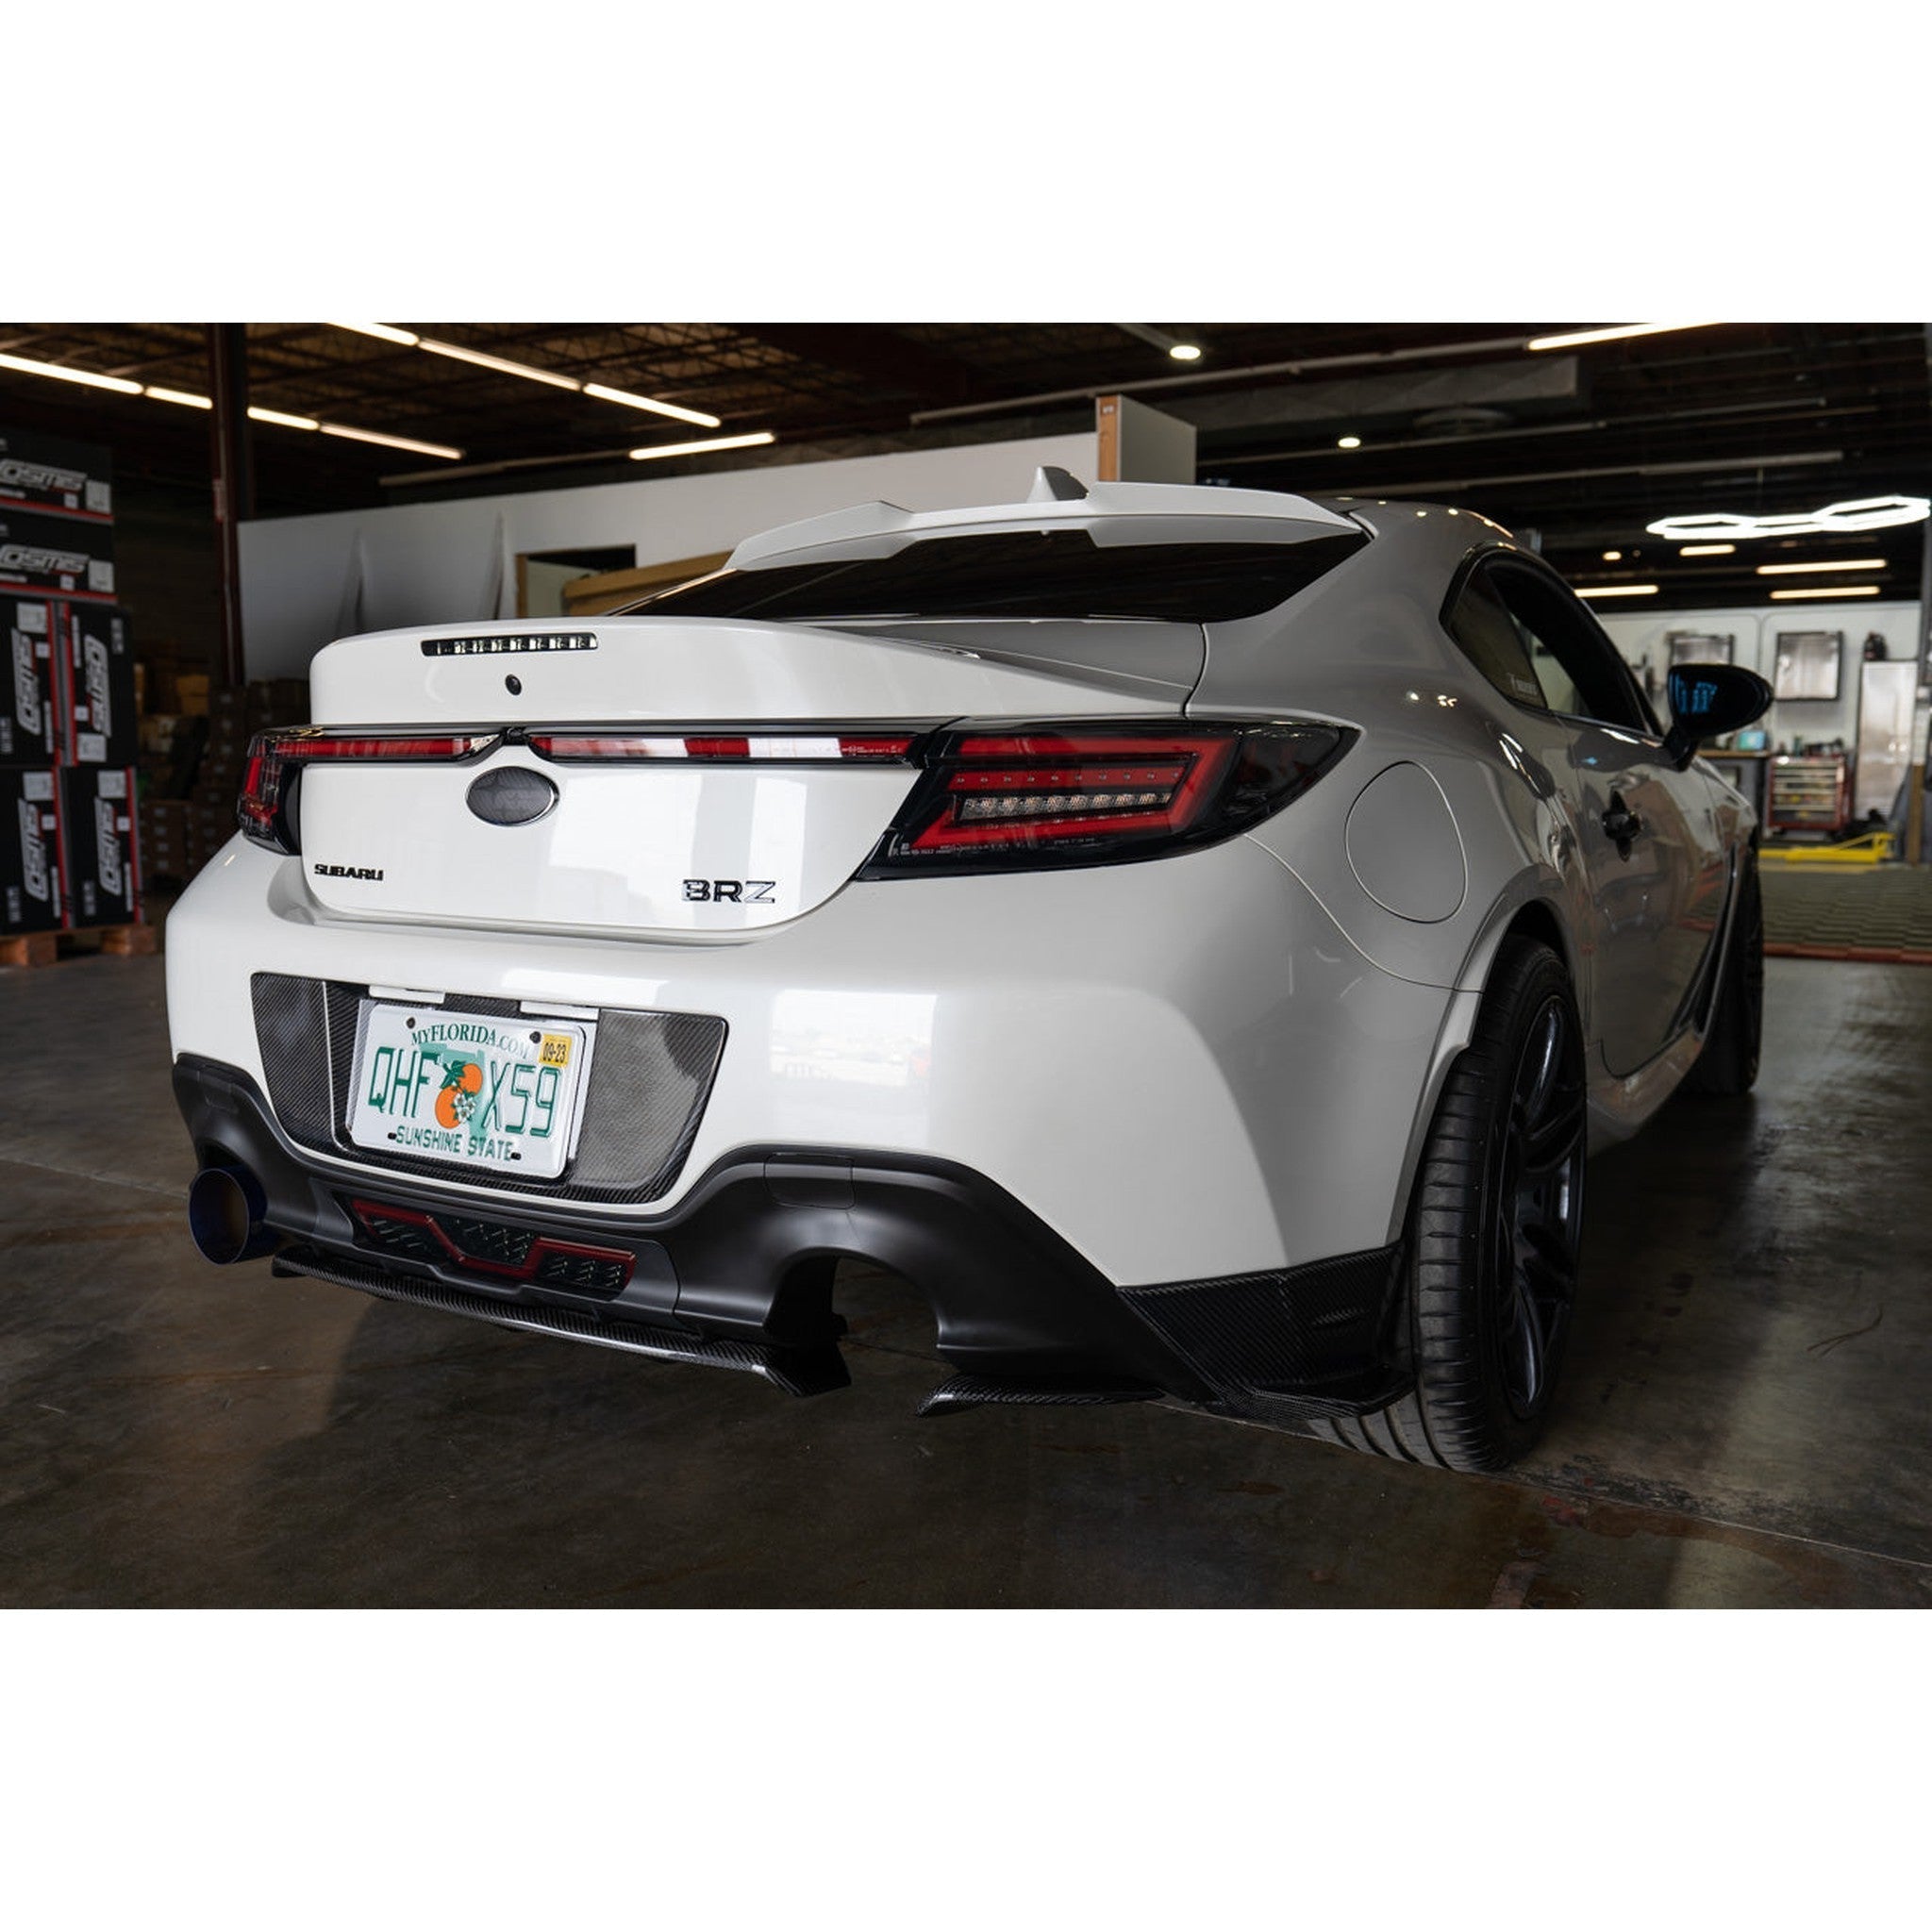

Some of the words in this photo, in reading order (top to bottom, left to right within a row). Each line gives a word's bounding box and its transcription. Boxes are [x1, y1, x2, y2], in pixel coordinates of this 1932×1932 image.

[314, 863, 384, 881] SUBARU
[682, 879, 776, 904] BRZ
[541, 1041, 568, 1064] 09-23
[367, 1045, 442, 1119] QHF
[481, 1059, 563, 1139] X59
[395, 1124, 463, 1154] SUNSHINE
[467, 1137, 514, 1161] STATE
